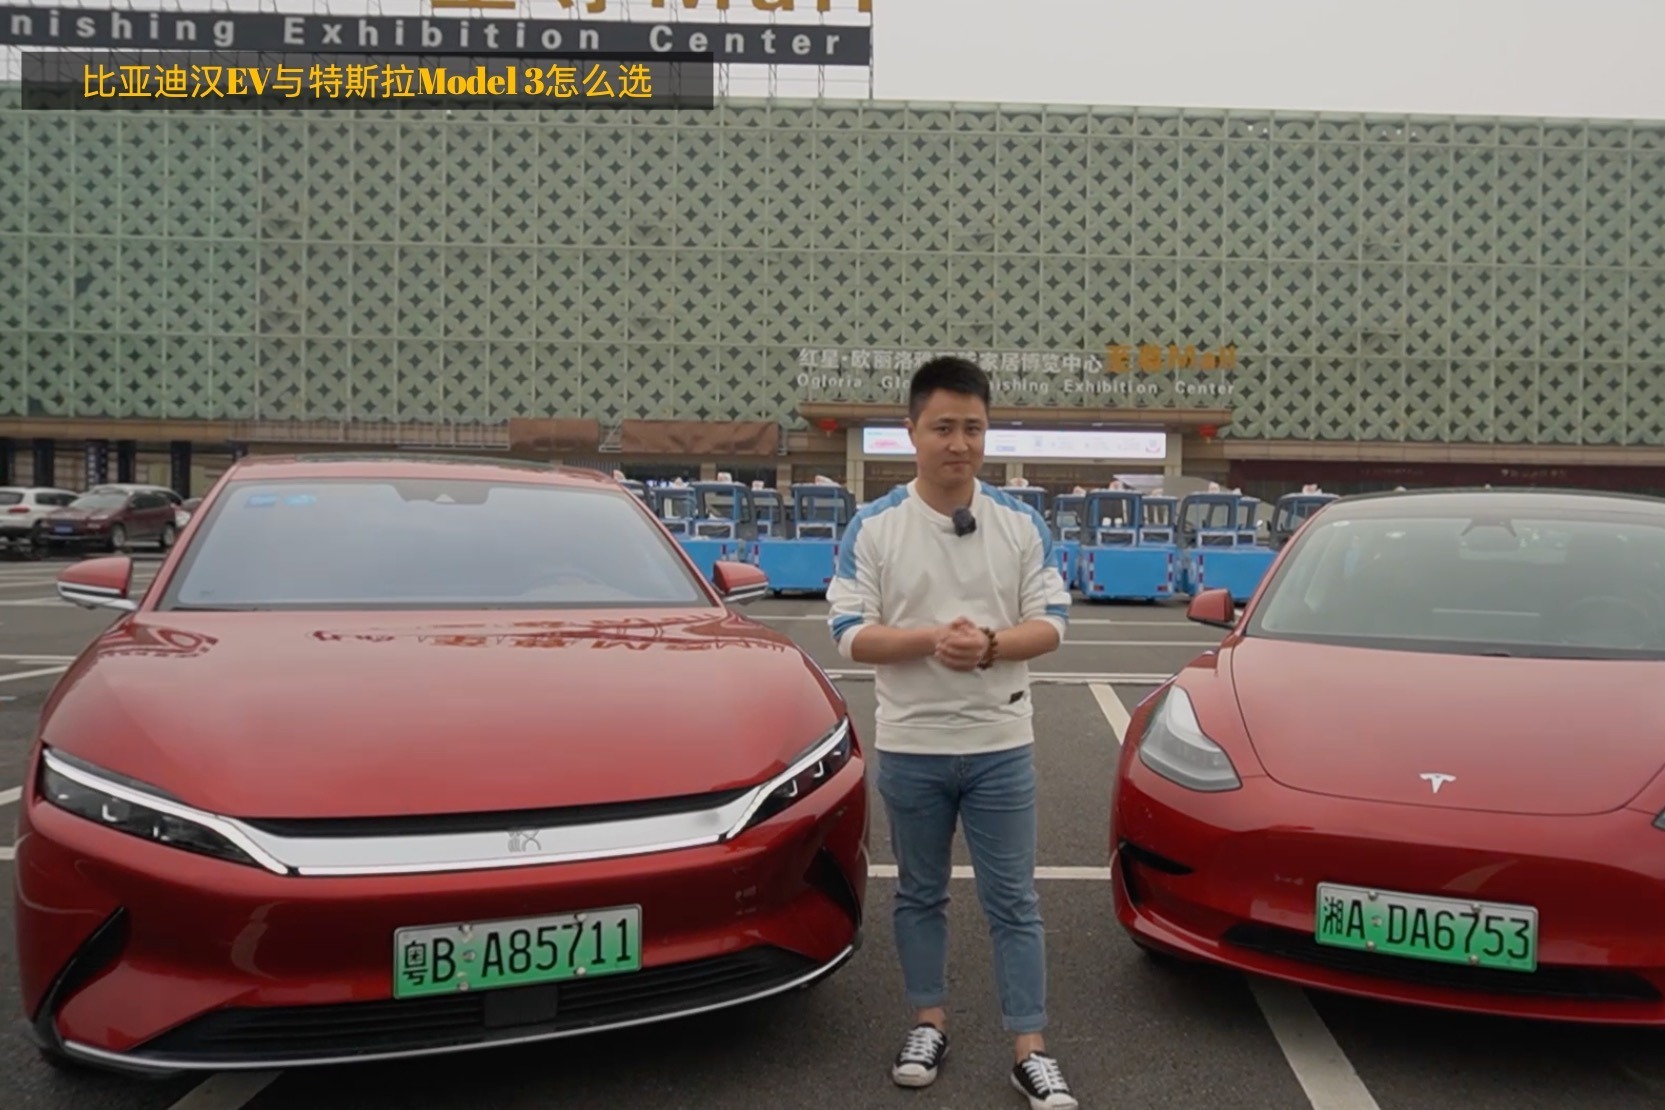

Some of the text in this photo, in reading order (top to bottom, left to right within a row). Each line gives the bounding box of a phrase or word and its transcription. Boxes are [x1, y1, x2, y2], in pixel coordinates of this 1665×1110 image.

[283, 16, 600, 51] Exhibition
[649, 24, 840, 56] Center
[881, 374, 913, 390] Glo
[989, 378, 1050, 395] nishing
[1063, 378, 1159, 394] Exhibition
[1174, 380, 1235, 395] Center
